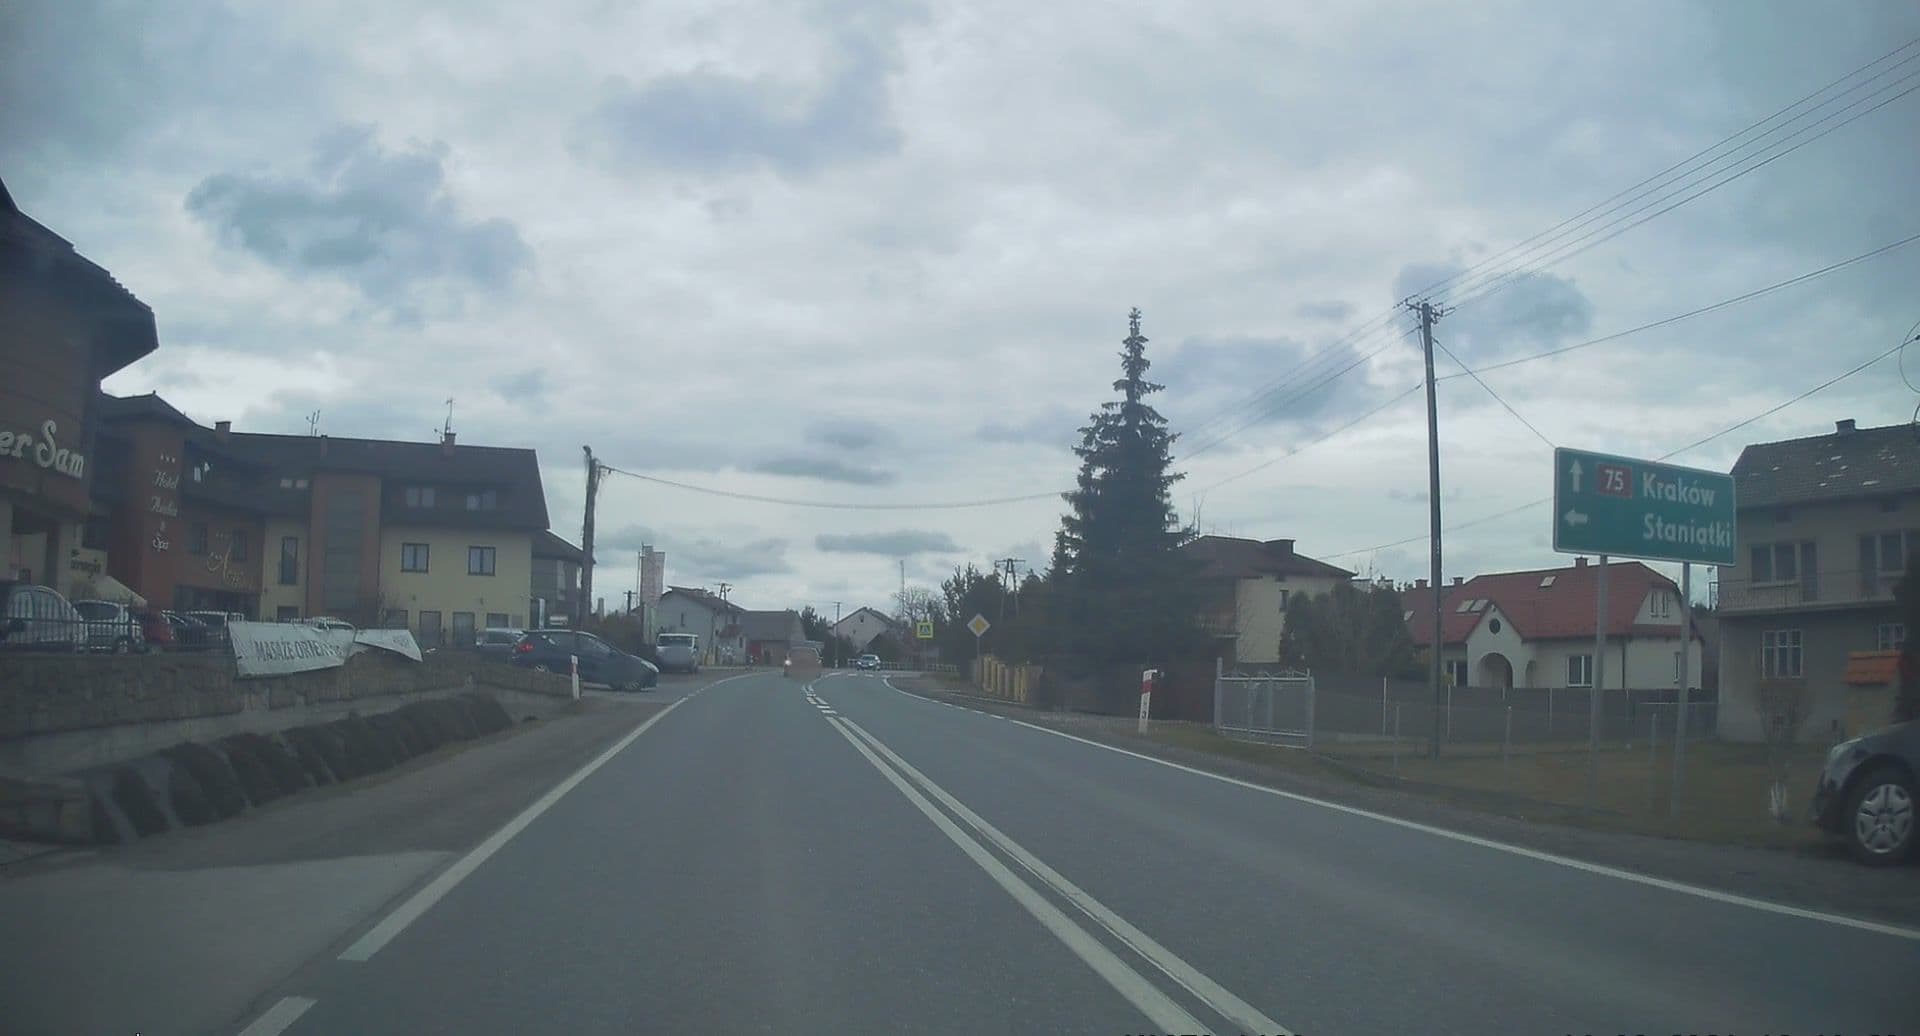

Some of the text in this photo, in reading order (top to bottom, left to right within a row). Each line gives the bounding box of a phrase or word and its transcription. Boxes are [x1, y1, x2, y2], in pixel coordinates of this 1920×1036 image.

[35, 419, 85, 479] Sam
[1604, 468, 1716, 507] 75 Kraków
[1643, 512, 1731, 552] Staniątki
